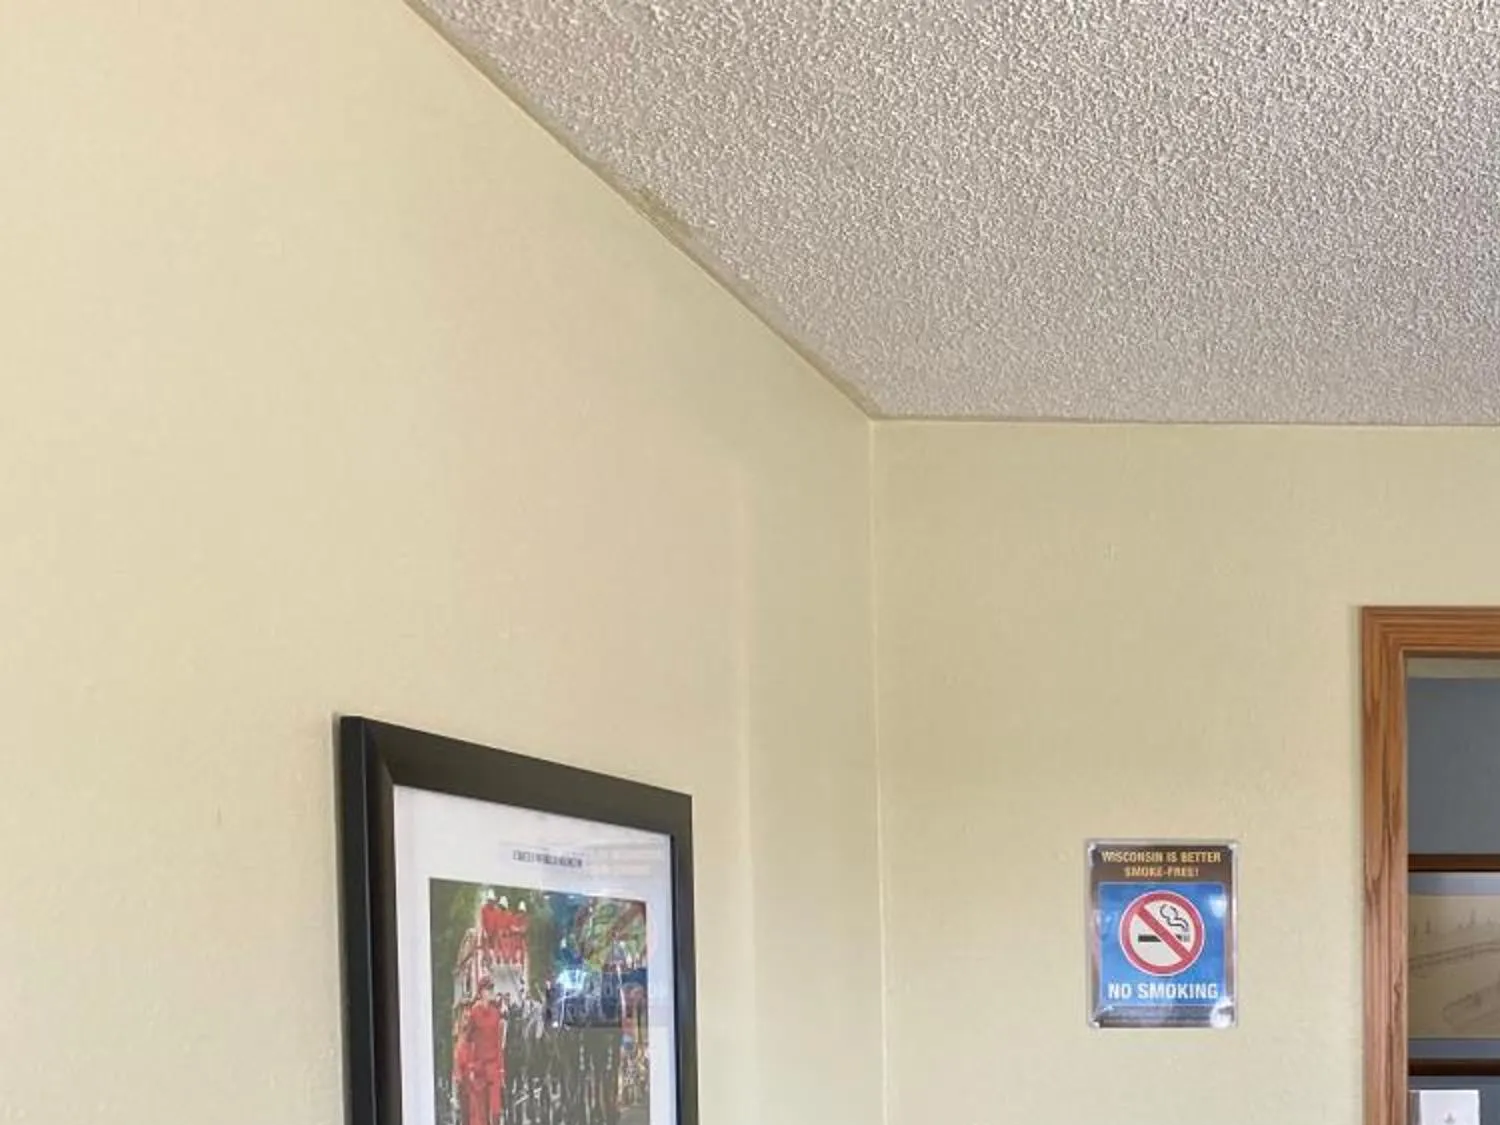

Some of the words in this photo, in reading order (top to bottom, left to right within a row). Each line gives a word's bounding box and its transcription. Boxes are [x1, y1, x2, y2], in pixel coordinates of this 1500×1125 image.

[1101, 851, 1164, 863] WISCONSIN
[1166, 851, 1177, 863] IS
[1181, 851, 1222, 863] BETTER
[1108, 982, 1132, 999] NO
[1137, 982, 1219, 999] SMOKING
